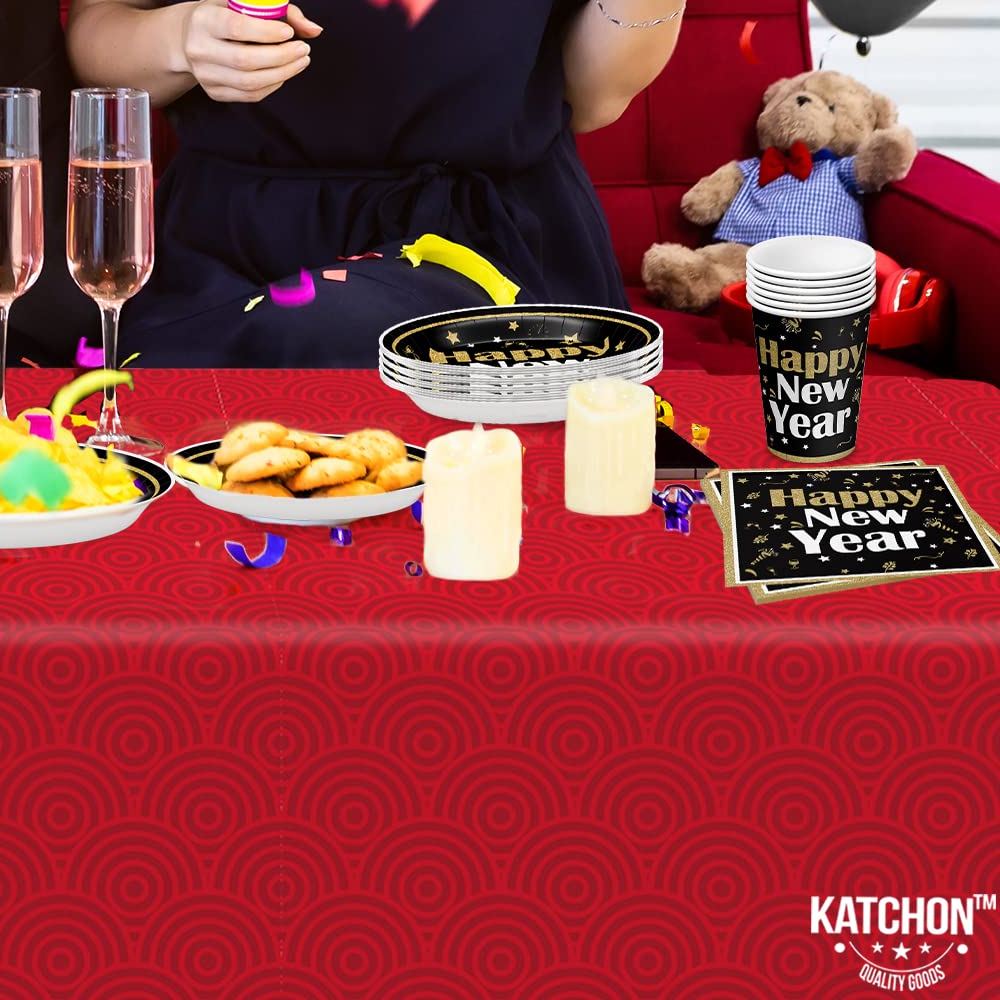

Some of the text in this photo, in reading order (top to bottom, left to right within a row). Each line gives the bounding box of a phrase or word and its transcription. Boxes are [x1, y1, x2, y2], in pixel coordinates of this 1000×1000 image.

[429, 336, 610, 364] Happy
[757, 335, 865, 379] Happy
[776, 372, 850, 405] New
[768, 399, 852, 440] Year
[769, 488, 923, 509] Happy
[803, 507, 909, 529] New
[788, 528, 927, 555] Year
